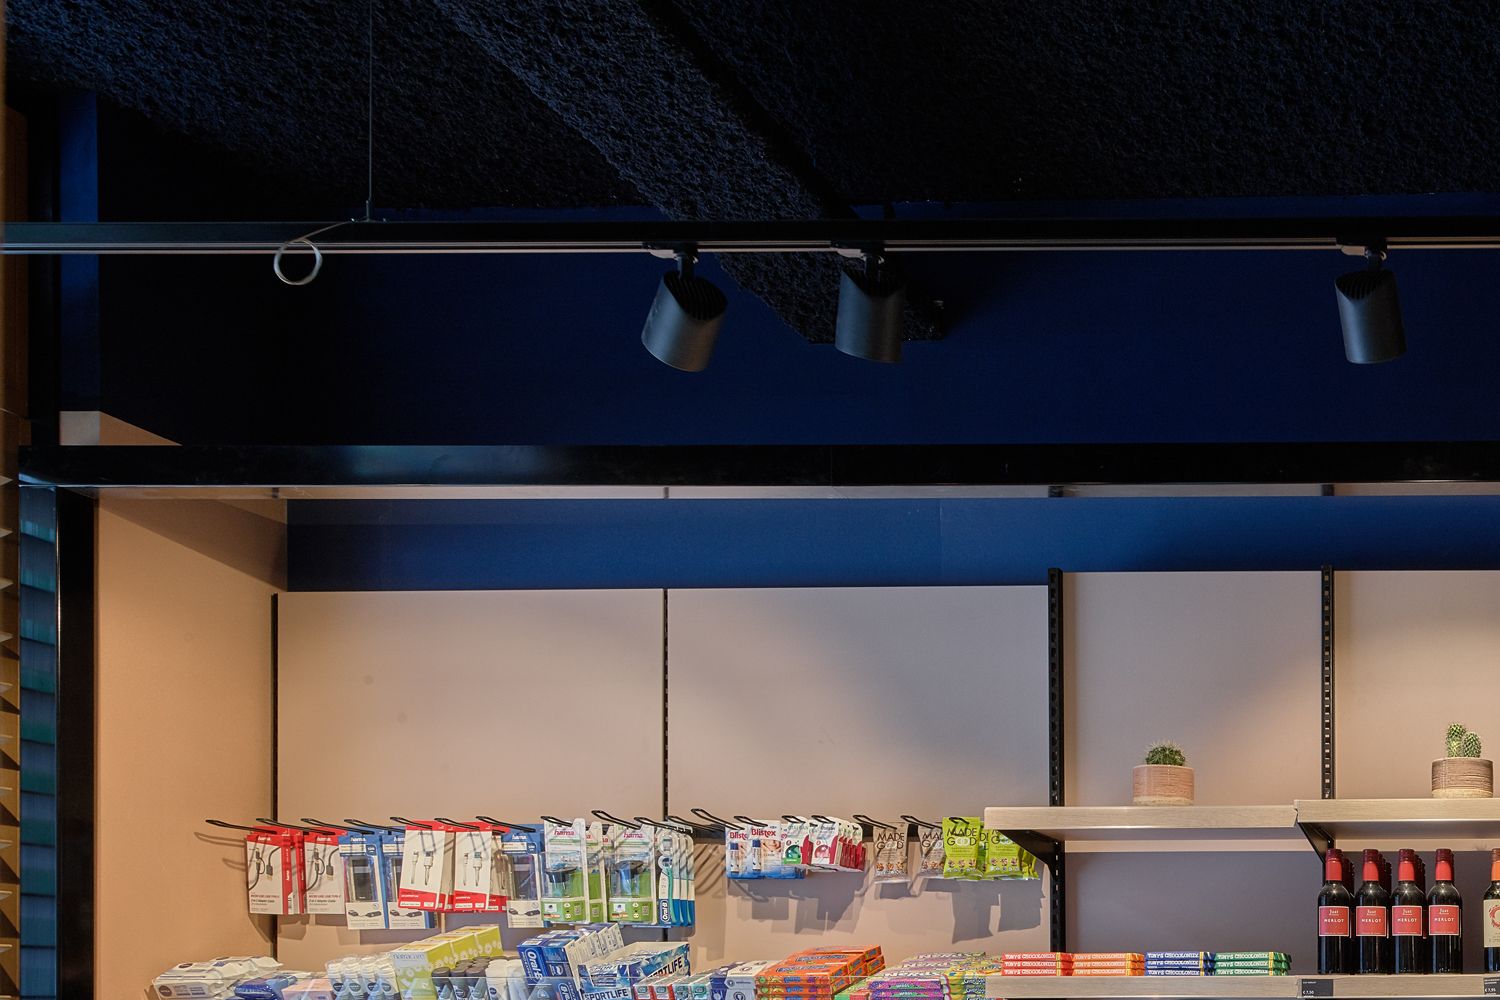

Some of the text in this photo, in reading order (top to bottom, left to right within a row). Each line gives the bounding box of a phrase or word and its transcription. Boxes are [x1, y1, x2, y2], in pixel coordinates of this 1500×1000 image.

[624, 831, 643, 839] hama
[947, 828, 977, 836] MADE
[878, 833, 904, 841] MADE
[922, 833, 943, 841] MAD
[947, 837, 977, 845] GOOD
[877, 841, 903, 850] GOOD
